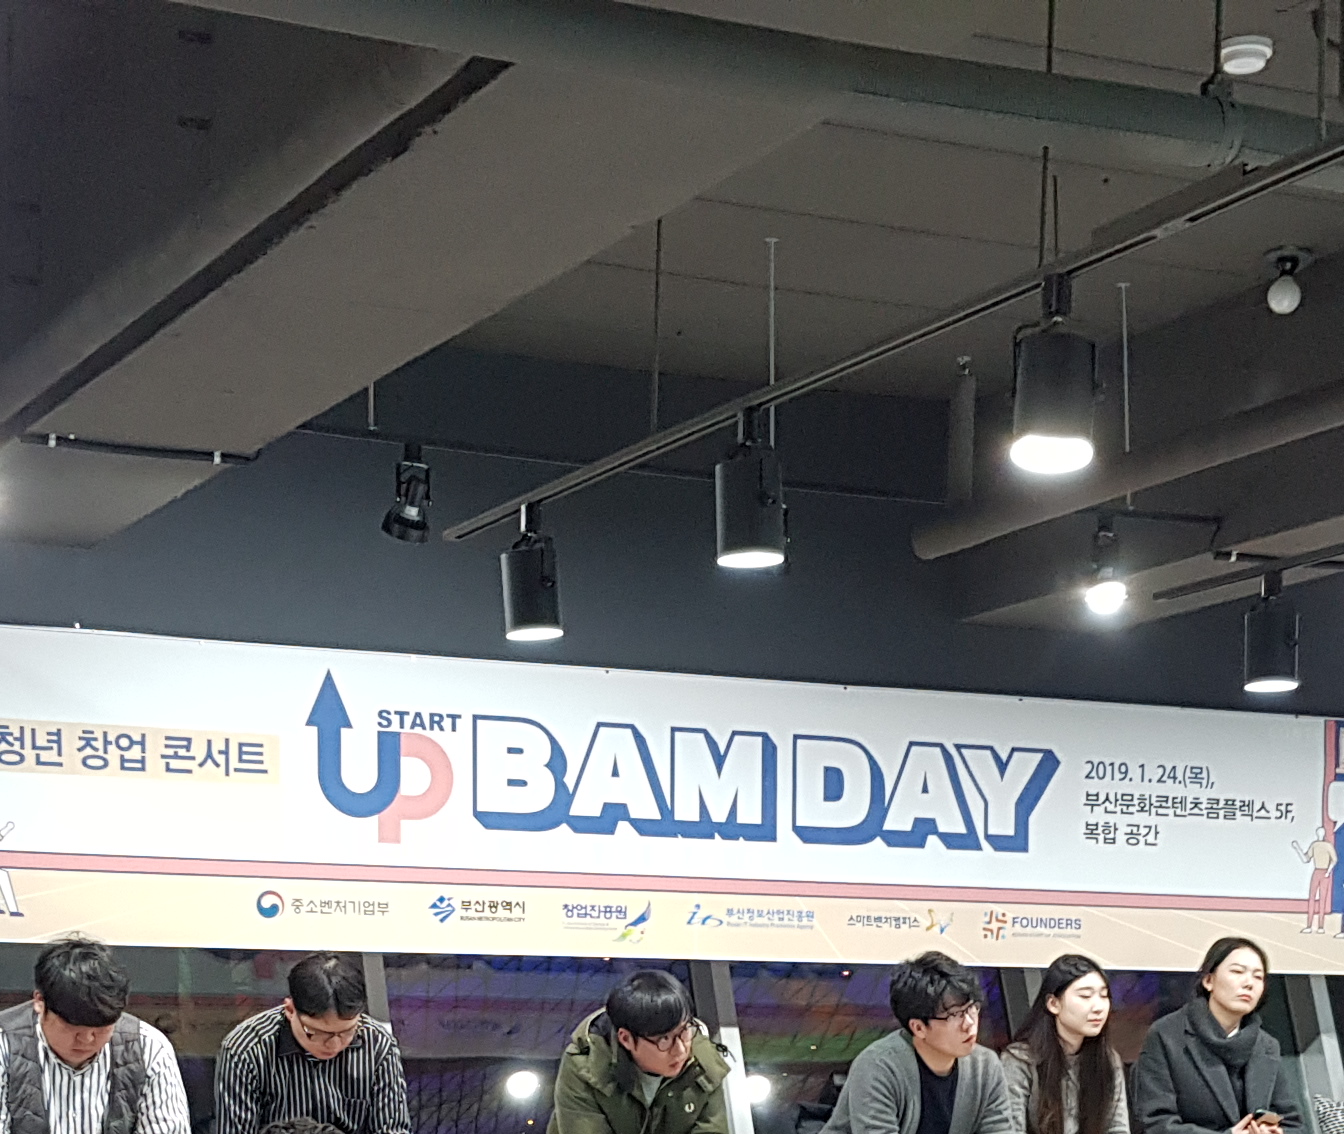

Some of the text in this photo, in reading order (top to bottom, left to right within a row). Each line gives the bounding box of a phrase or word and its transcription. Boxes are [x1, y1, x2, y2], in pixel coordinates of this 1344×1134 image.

[376, 709, 462, 733] START
[76, 728, 147, 773] 창업
[159, 734, 269, 777] 콘서트
[472, 714, 777, 842] BAM
[792, 733, 1061, 853] DAY
[1082, 790, 1296, 824] 부산문화콘텐츠콤플렉스 5F,
[1082, 821, 1160, 847] 복합 공간
[290, 898, 390, 917] 중소벤처기업부
[460, 899, 526, 915] 부산광역시
[562, 903, 628, 920] 창업진흥원
[1011, 916, 1082, 930] FOUNDERS
